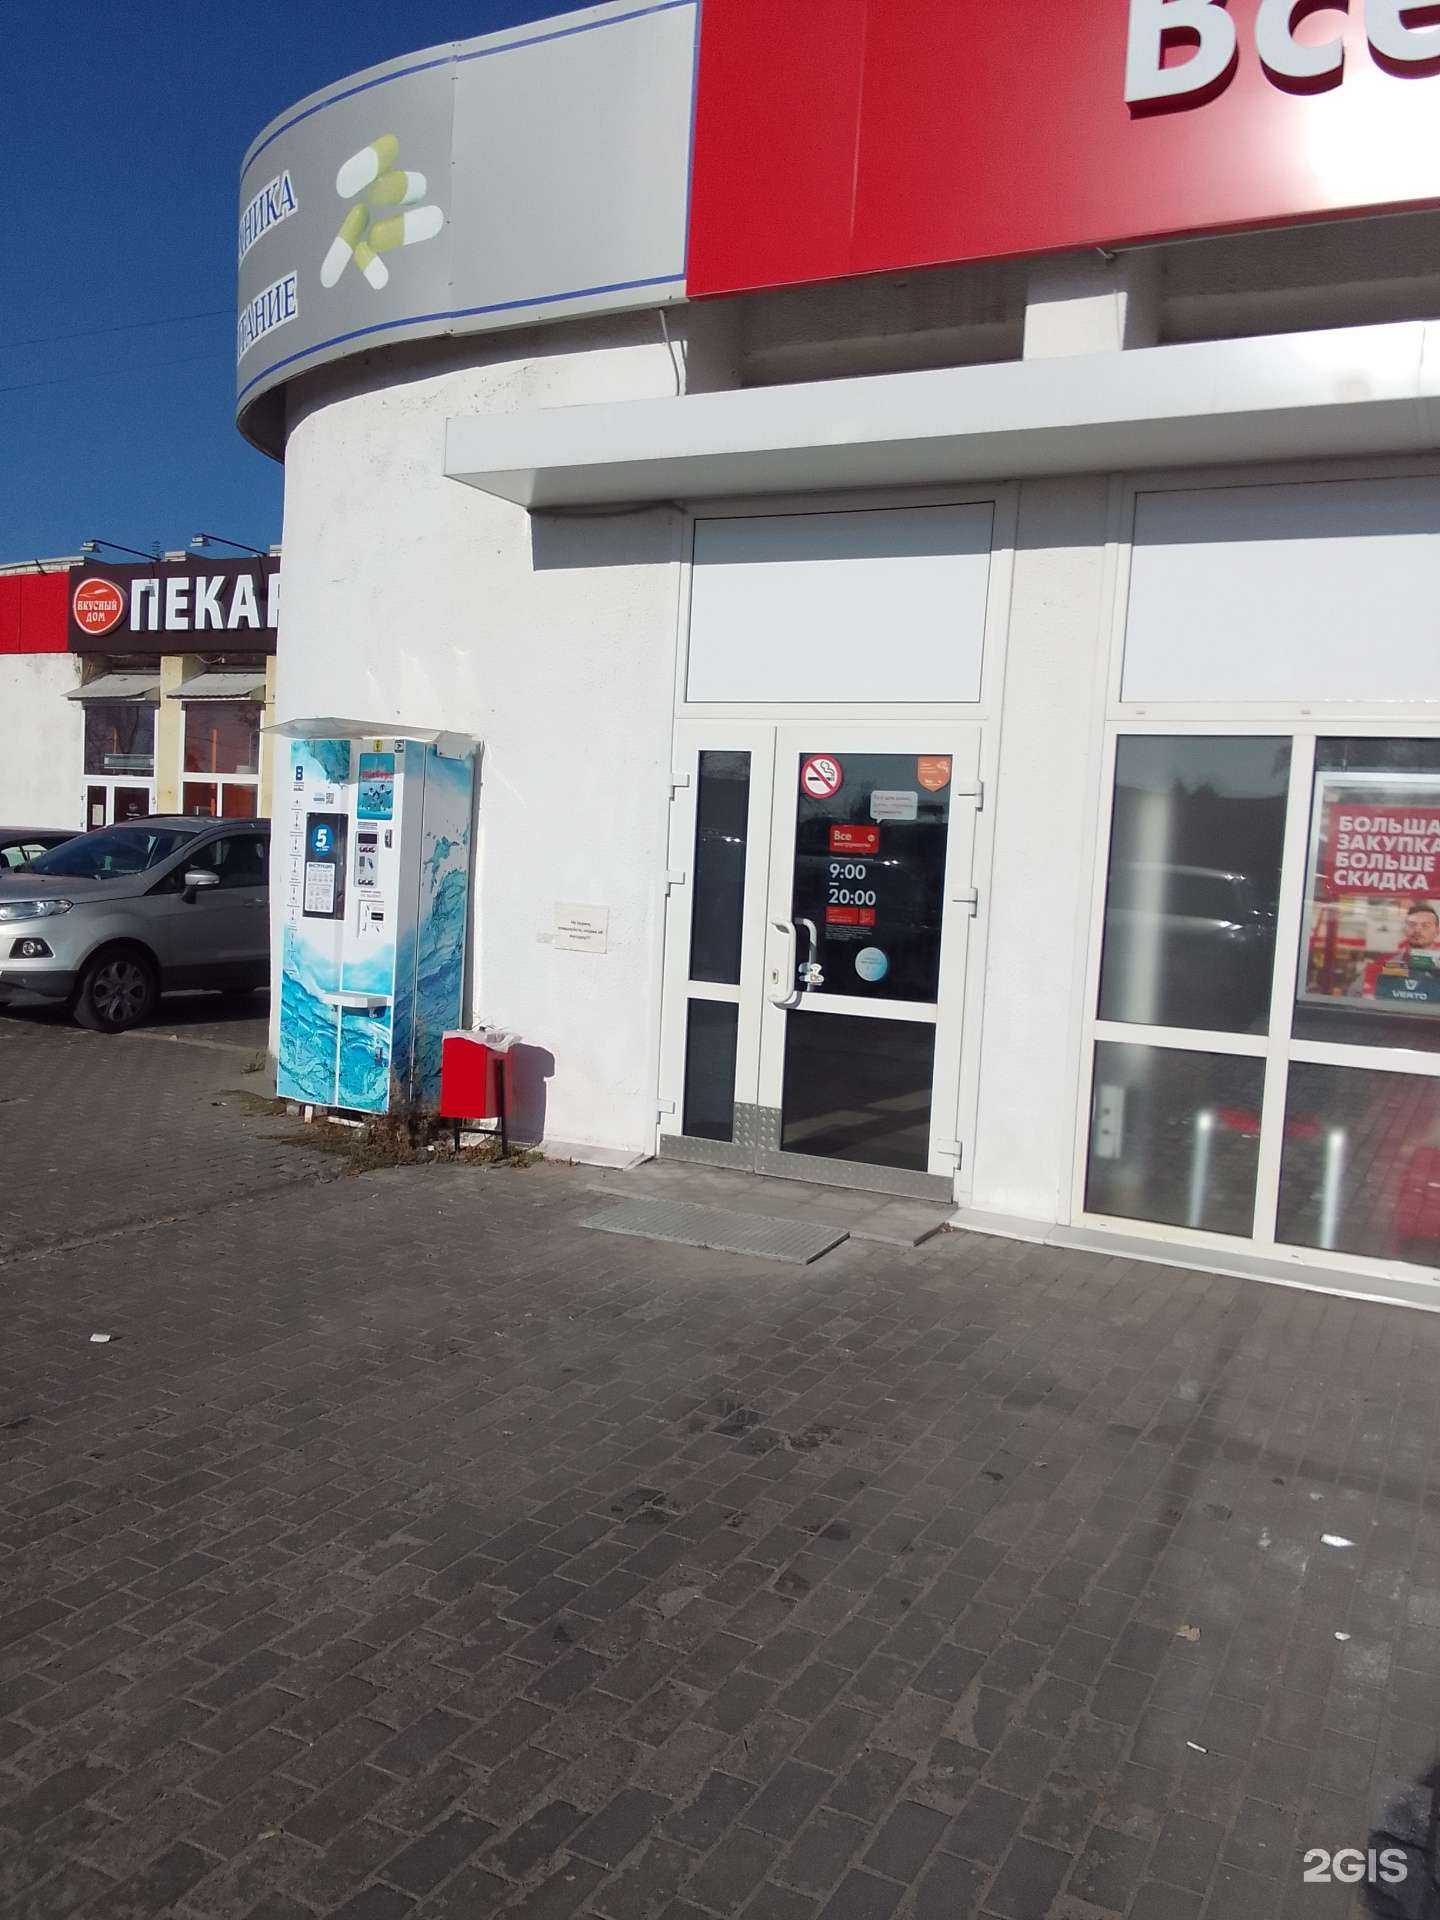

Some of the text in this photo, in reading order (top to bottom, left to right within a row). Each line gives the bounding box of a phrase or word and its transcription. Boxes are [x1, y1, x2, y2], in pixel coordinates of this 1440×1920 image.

[77, 599, 118, 611] ВКУСНЫЙ
[85, 611, 106, 623] ДОМ
[1338, 815, 1440, 837] БОЛЬША
[315, 828, 328, 849] 5
[1336, 833, 1440, 855] ЗАКУПКА
[829, 863, 867, 880] 9:00
[1335, 851, 1436, 873] БОЛЬШЕ
[1333, 869, 1430, 892] СКИДКА
[828, 888, 877, 906] 20:00
